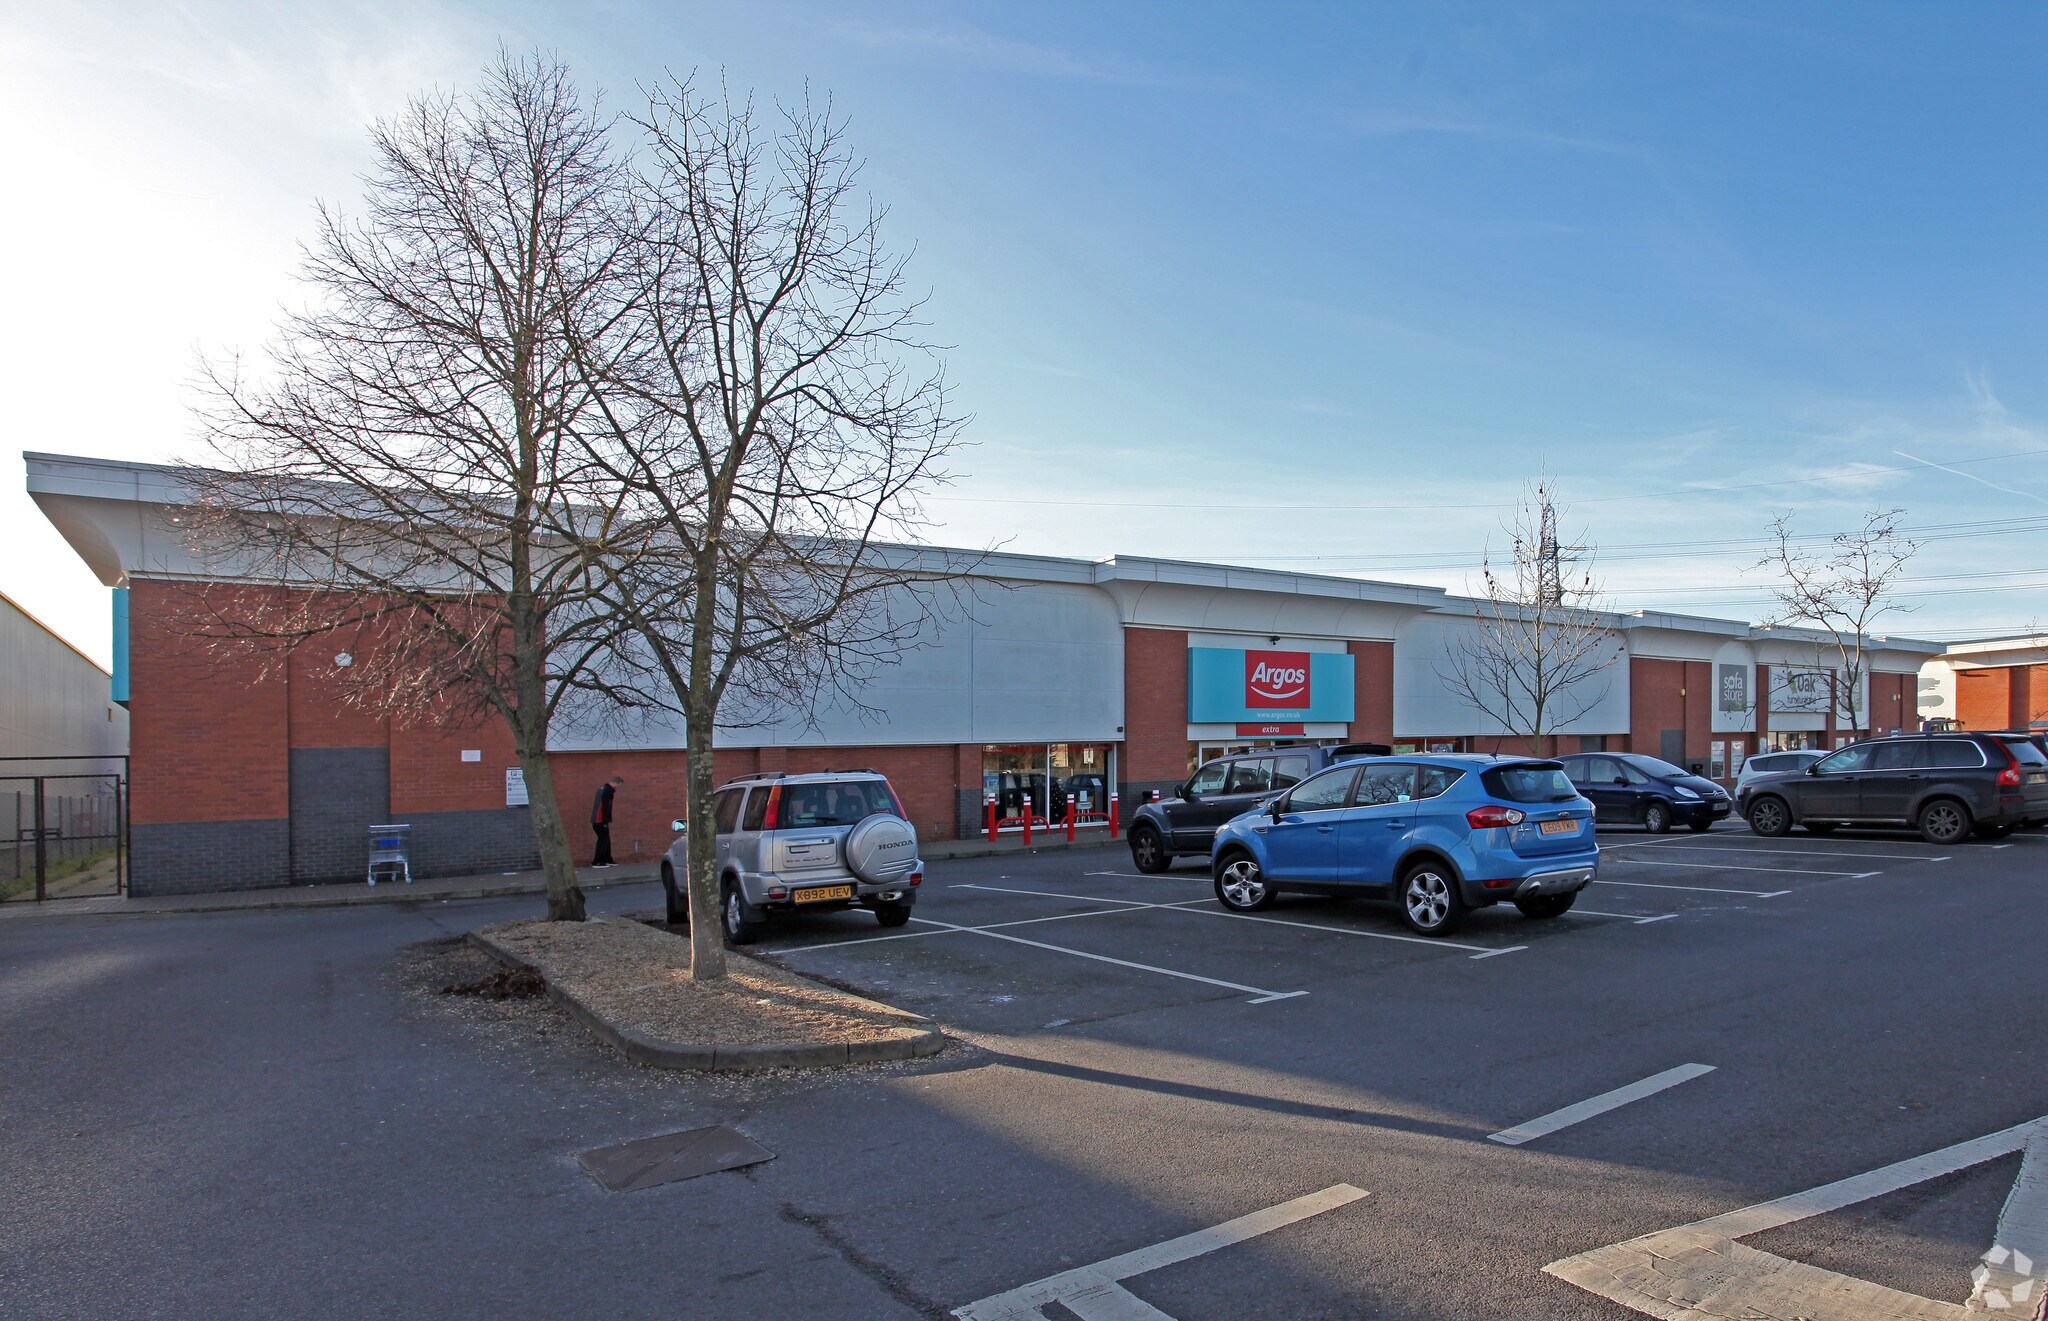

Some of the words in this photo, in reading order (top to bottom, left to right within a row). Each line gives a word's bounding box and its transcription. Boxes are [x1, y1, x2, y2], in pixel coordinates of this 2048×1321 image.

[1251, 662, 1305, 689] Argos
[1724, 672, 1743, 689] sofa
[1724, 688, 1743, 701] store
[1256, 712, 1301, 720] www.argos.co.uk
[878, 840, 914, 850] HONDA
[796, 890, 825, 901] X892
[828, 887, 850, 898] UEV
